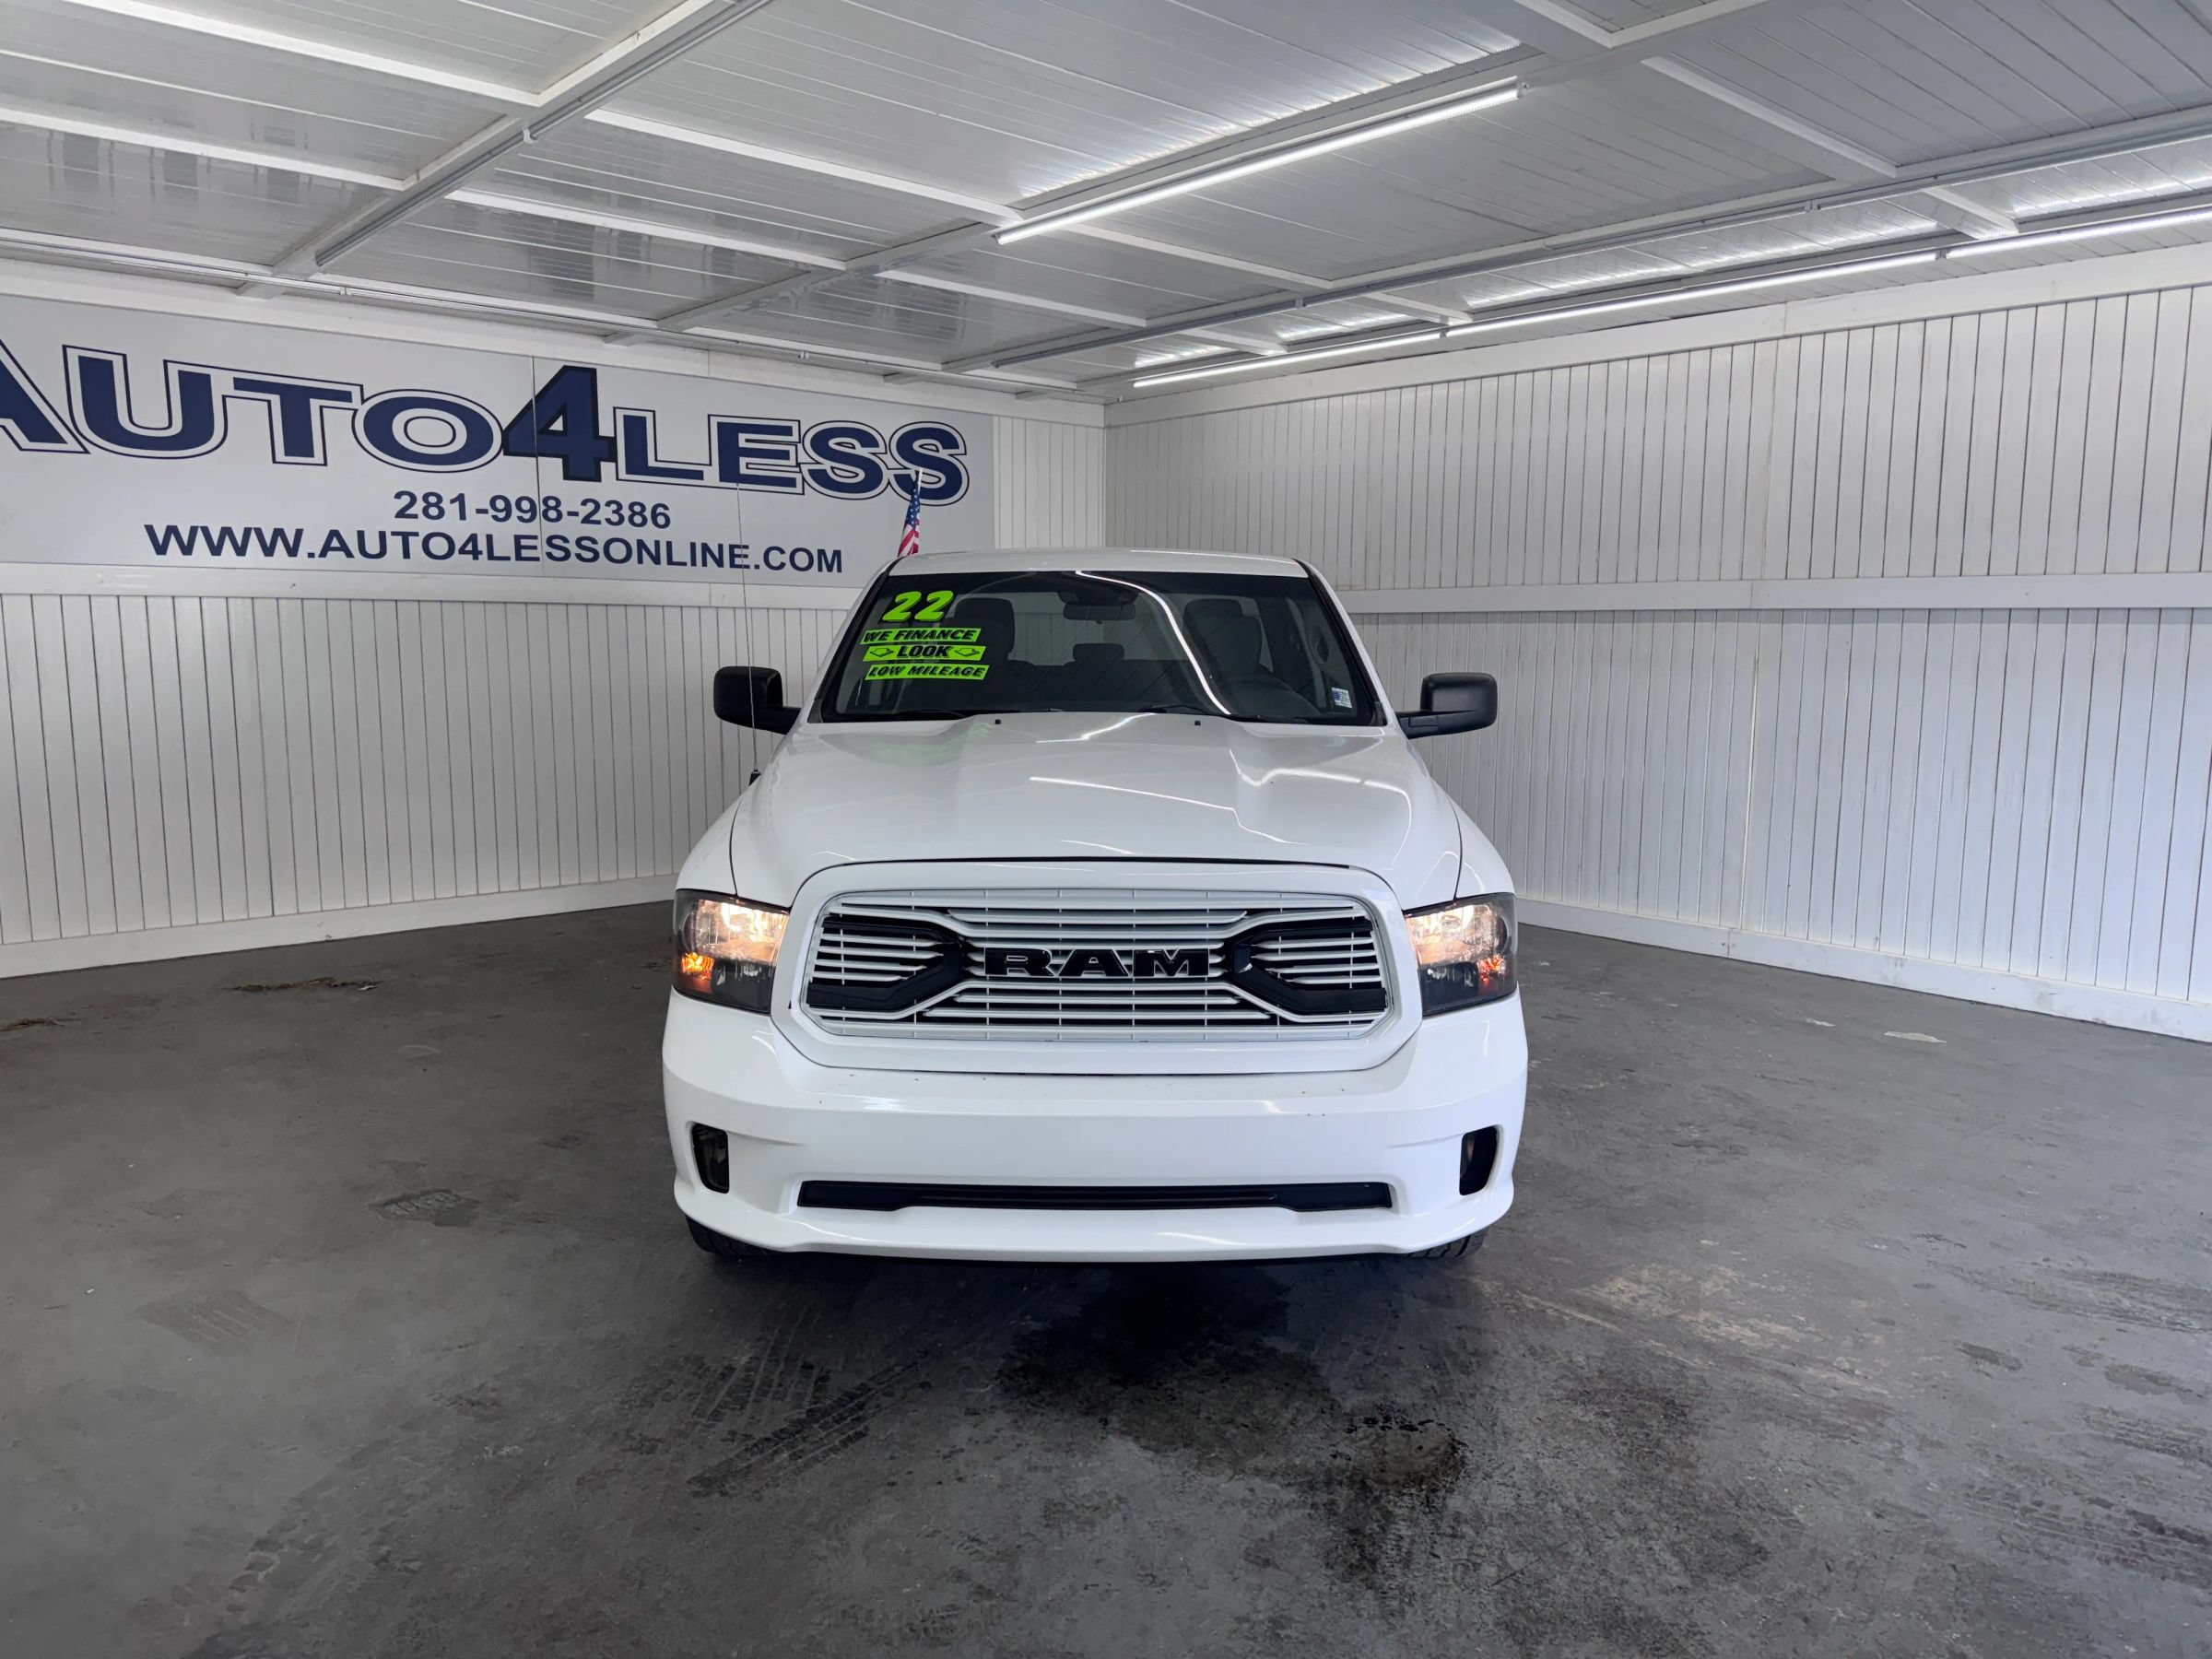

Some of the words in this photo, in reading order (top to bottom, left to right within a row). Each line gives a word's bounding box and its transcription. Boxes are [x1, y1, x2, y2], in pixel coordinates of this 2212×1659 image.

[394, 489, 671, 529] 281-998-2386
[145, 524, 842, 573] WWW.AUTO4LESSONLINE.COM
[881, 590, 954, 622] 22
[864, 630, 891, 642] WE
[893, 629, 976, 641] FINANCE
[897, 645, 952, 658] LOOK
[868, 665, 906, 677] LOW
[908, 665, 985, 677] MILEAGE
[984, 947, 1209, 977] RAM
